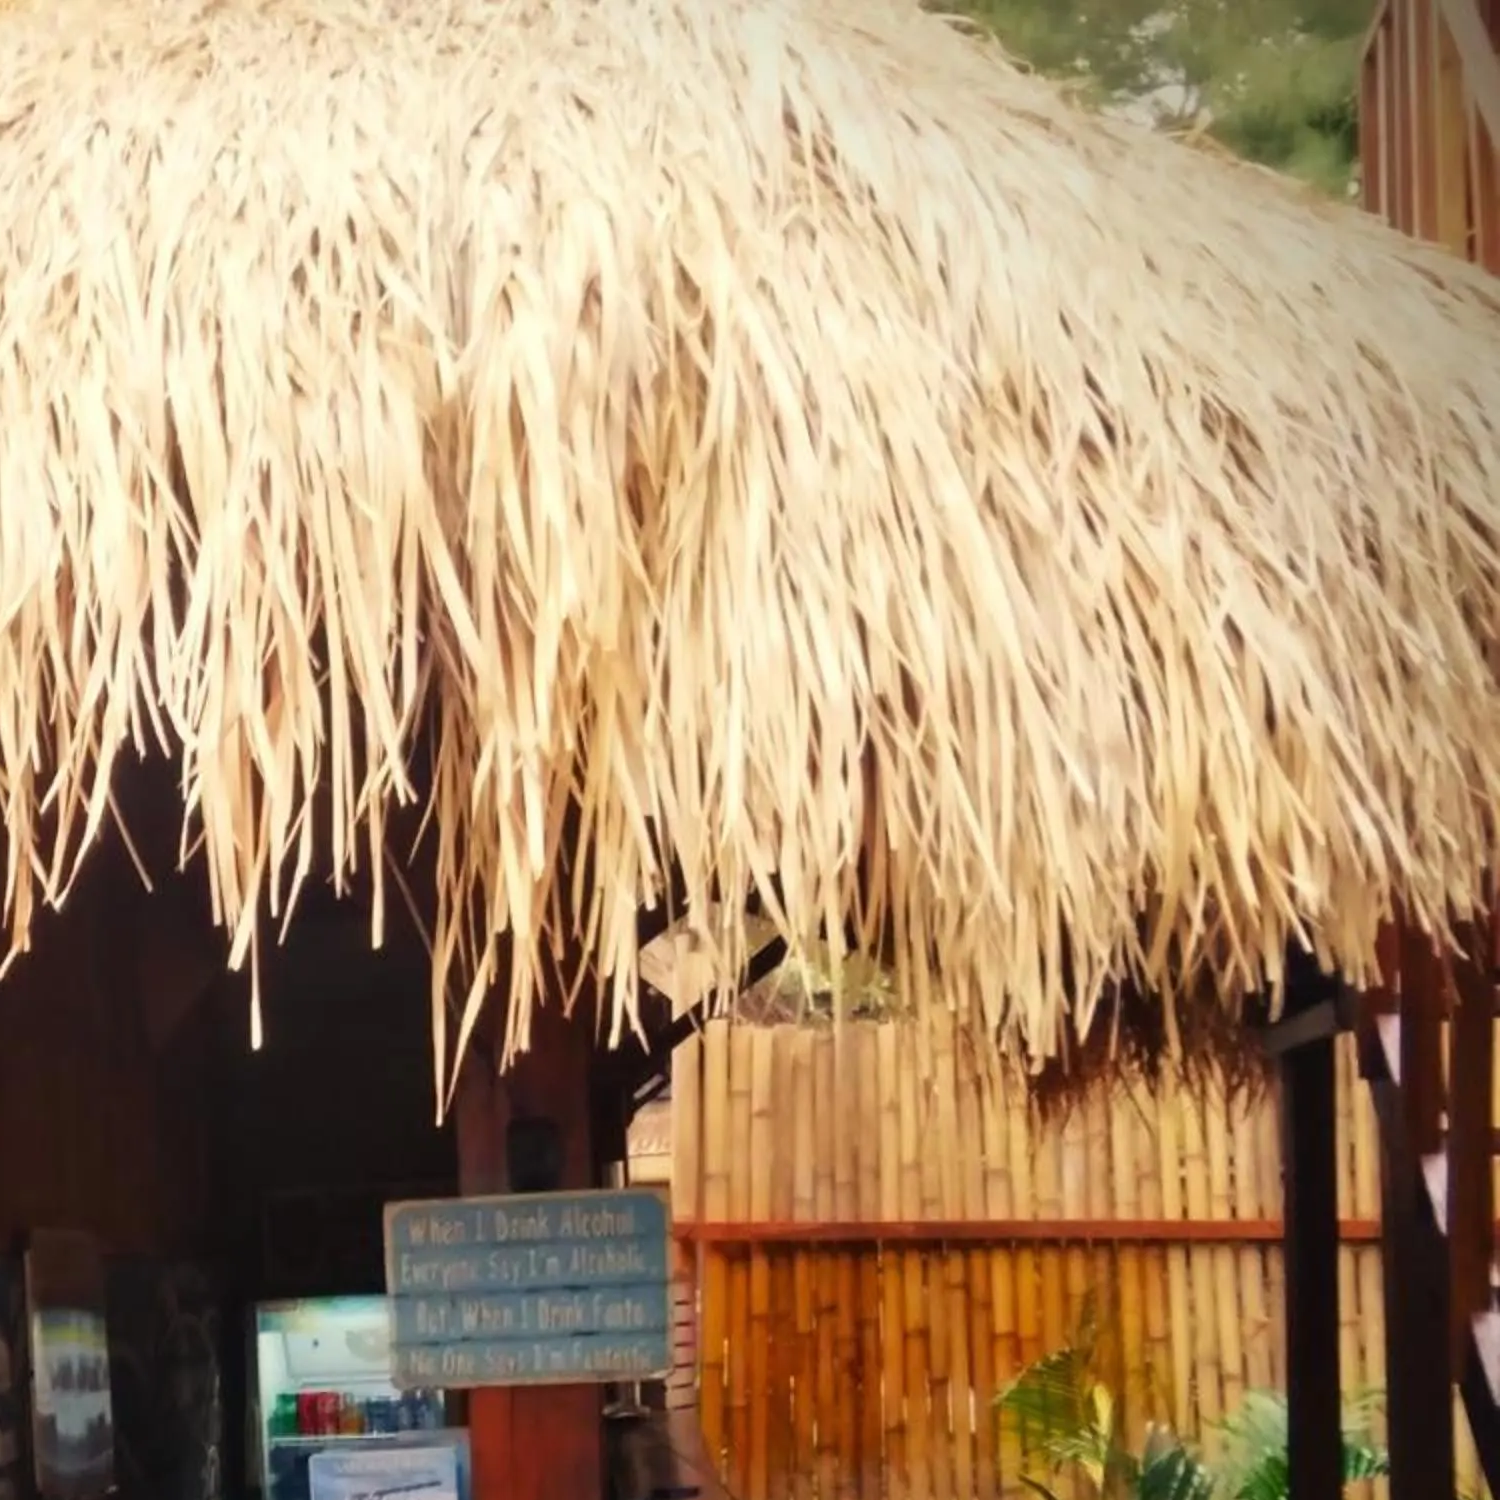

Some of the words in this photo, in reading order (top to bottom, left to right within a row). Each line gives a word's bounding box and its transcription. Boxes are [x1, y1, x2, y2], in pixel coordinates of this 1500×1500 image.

[407, 1212, 466, 1245] When
[475, 1209, 485, 1242] I
[495, 1205, 550, 1243] Drink
[462, 1298, 513, 1333] When
[521, 1297, 529, 1330] I
[538, 1293, 583, 1332] Drink
